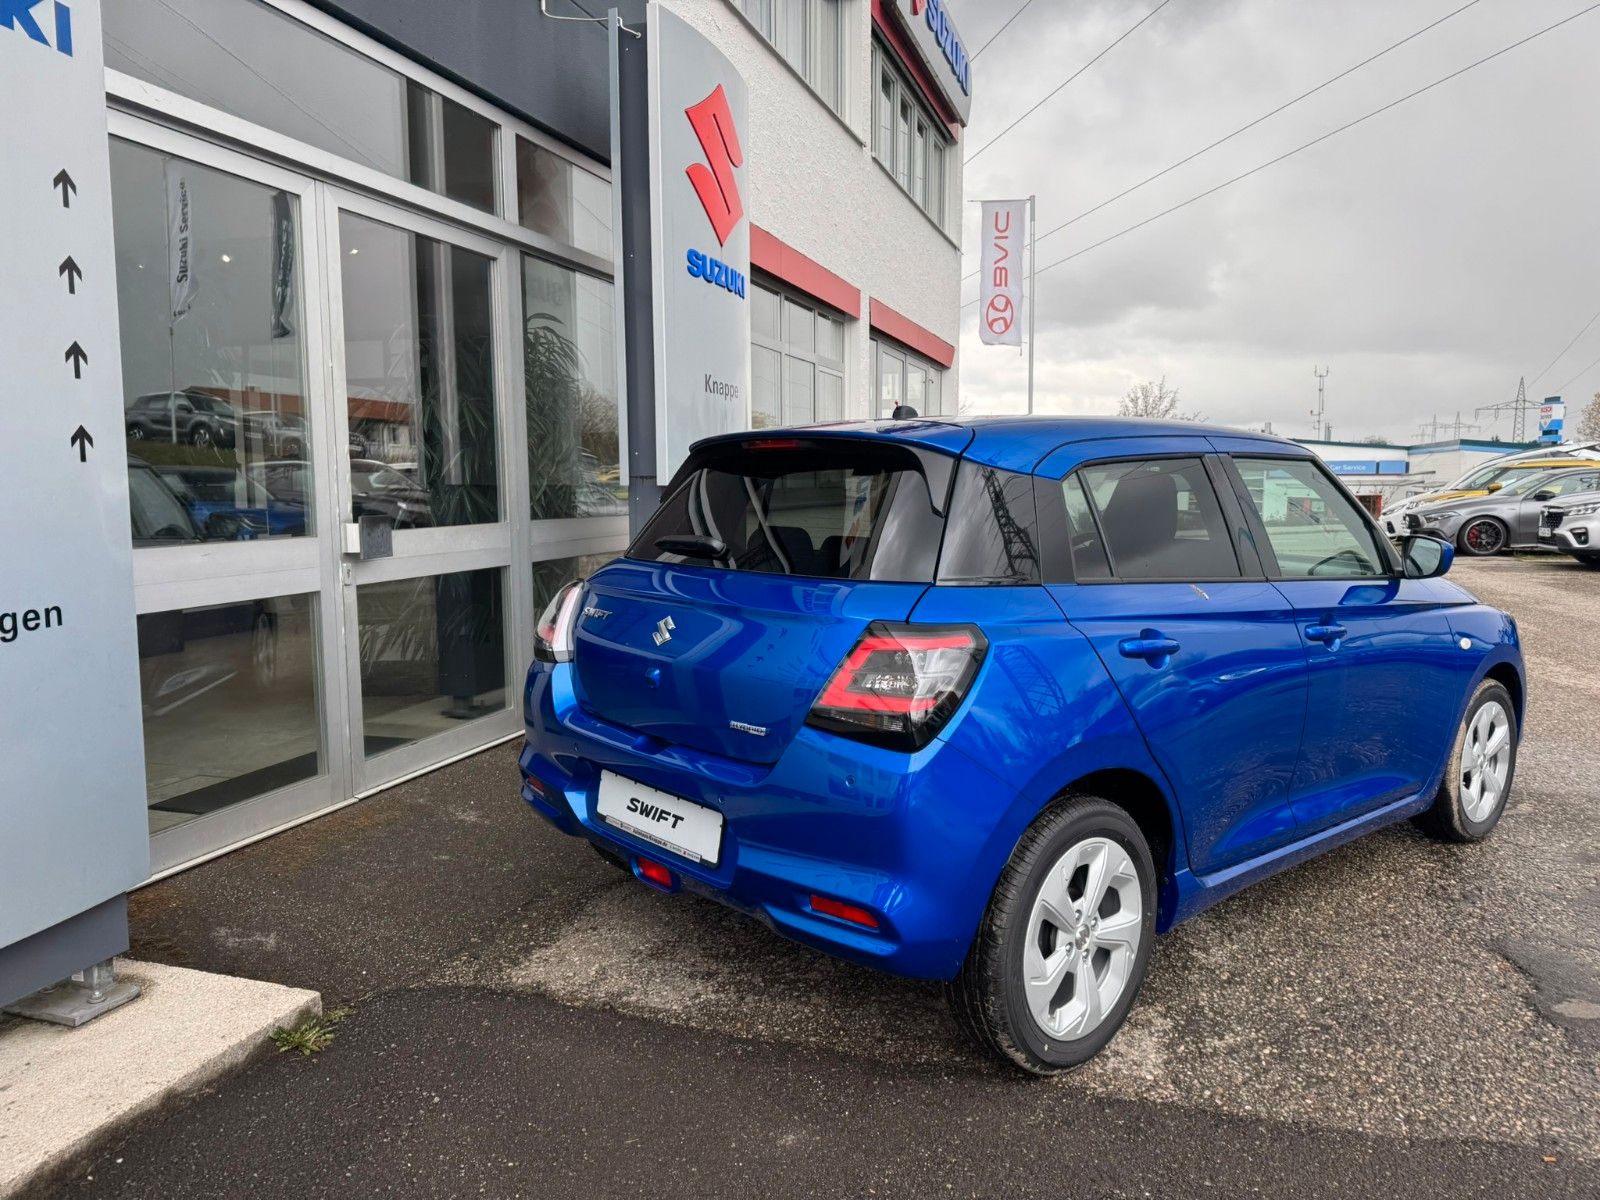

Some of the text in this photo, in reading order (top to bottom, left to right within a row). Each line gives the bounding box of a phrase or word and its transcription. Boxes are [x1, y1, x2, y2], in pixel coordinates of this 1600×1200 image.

[926, 0, 969, 96] SUZUKI
[686, 248, 745, 300] SUZUKI
[704, 373, 739, 402] Knappe
[0, 605, 63, 643] gen
[584, 606, 613, 620] SWIFT
[626, 797, 685, 829] SWIFT
